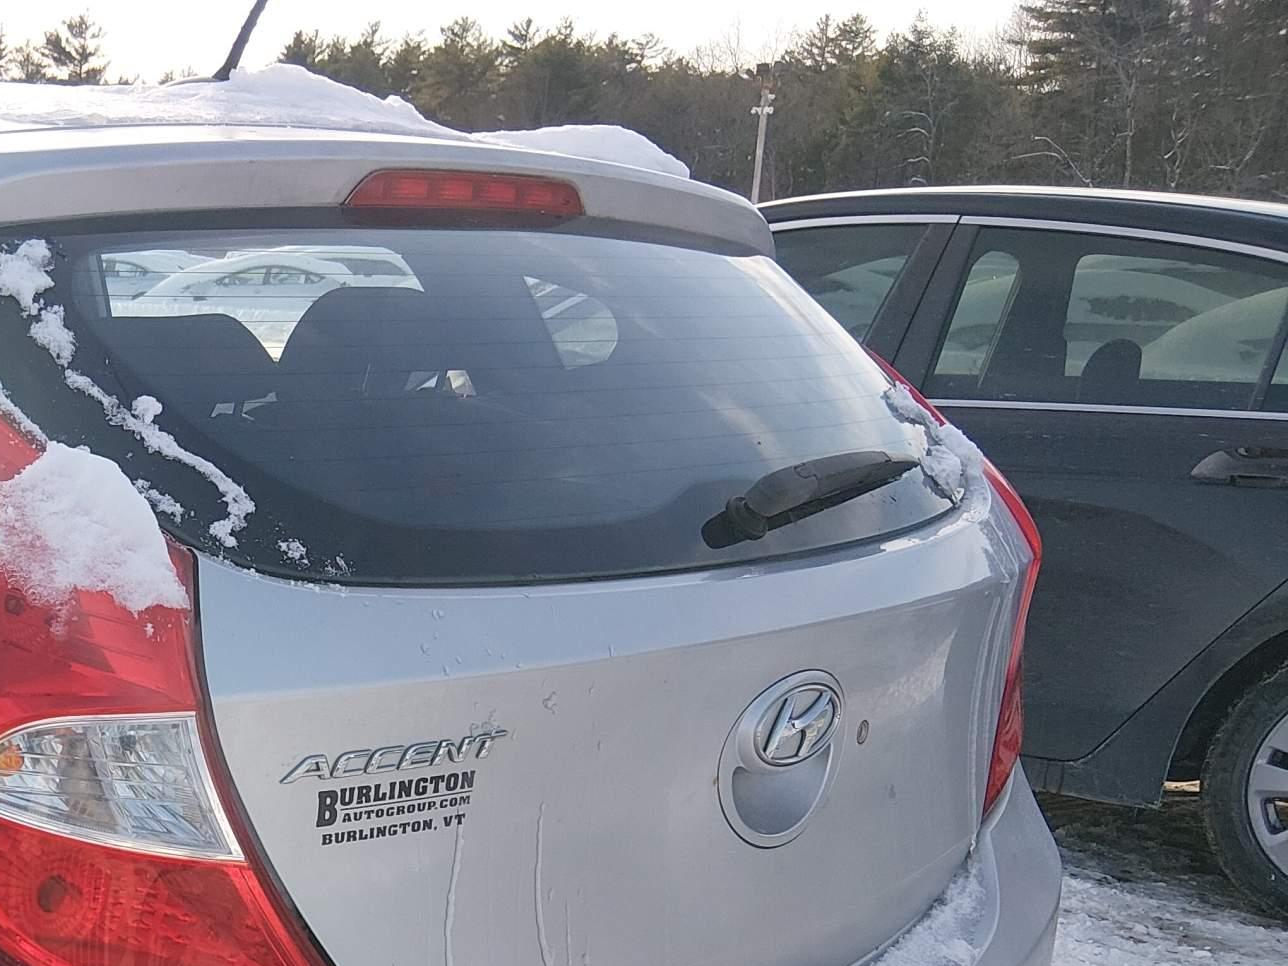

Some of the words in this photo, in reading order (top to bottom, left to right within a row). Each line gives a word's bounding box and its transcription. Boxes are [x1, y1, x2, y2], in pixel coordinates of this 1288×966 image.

[279, 730, 508, 784] ACCENT
[315, 770, 476, 828] BURLINGTON
[342, 795, 471, 823] AUTOGROUP.COM
[321, 818, 438, 846] BURLINGTON,
[443, 813, 466, 828] VT
